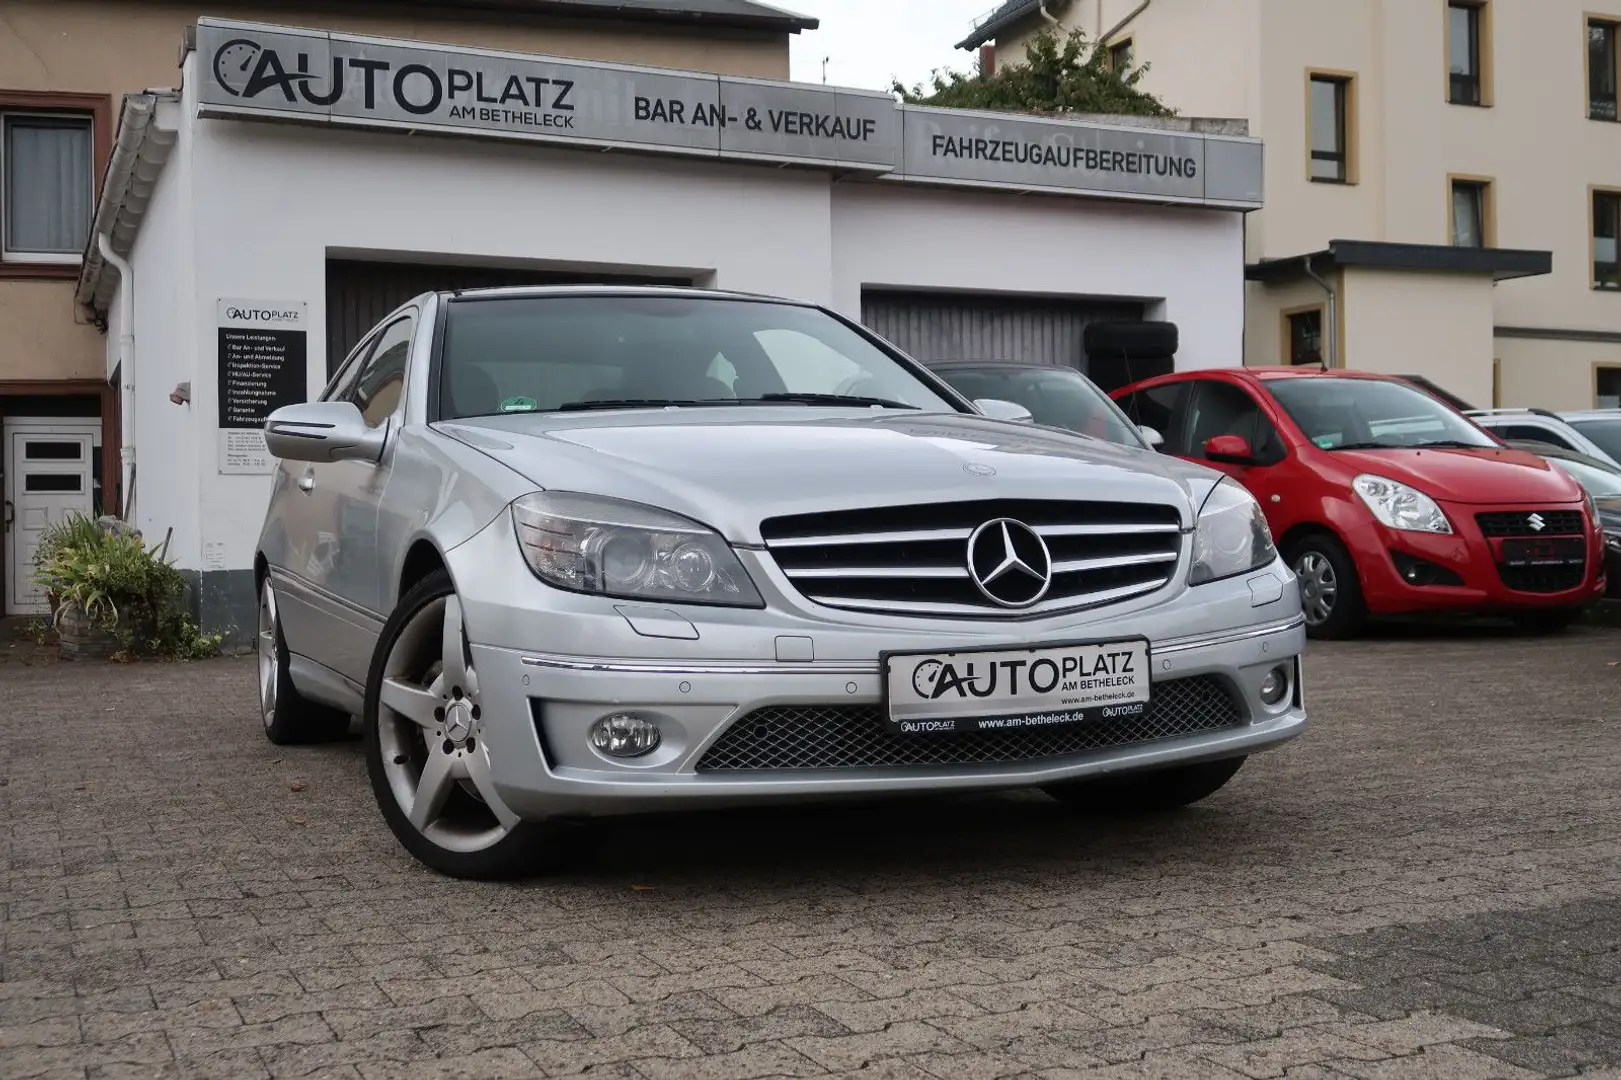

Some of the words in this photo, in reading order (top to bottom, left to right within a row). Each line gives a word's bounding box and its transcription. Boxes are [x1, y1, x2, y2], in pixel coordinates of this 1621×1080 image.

[449, 105, 476, 120] AM
[479, 108, 574, 129] BETHELECK
[634, 95, 685, 124] BAR
[691, 102, 738, 128] AN-
[744, 106, 763, 131] &
[768, 108, 876, 141] VERKAUF
[931, 134, 1197, 178] FAHRZEUGAUFBEREITUNG
[265, 345, 286, 353] Verkauf
[254, 354, 285, 362] Abmeldung
[231, 380, 267, 388] Finanzierung
[232, 398, 268, 406] Versicherung
[1061, 681, 1078, 692] AM
[1080, 675, 1135, 690] BETHELECK
[1061, 690, 1135, 705] www.am-betheleck.de
[978, 711, 1084, 729] www.am-betheleck.de
